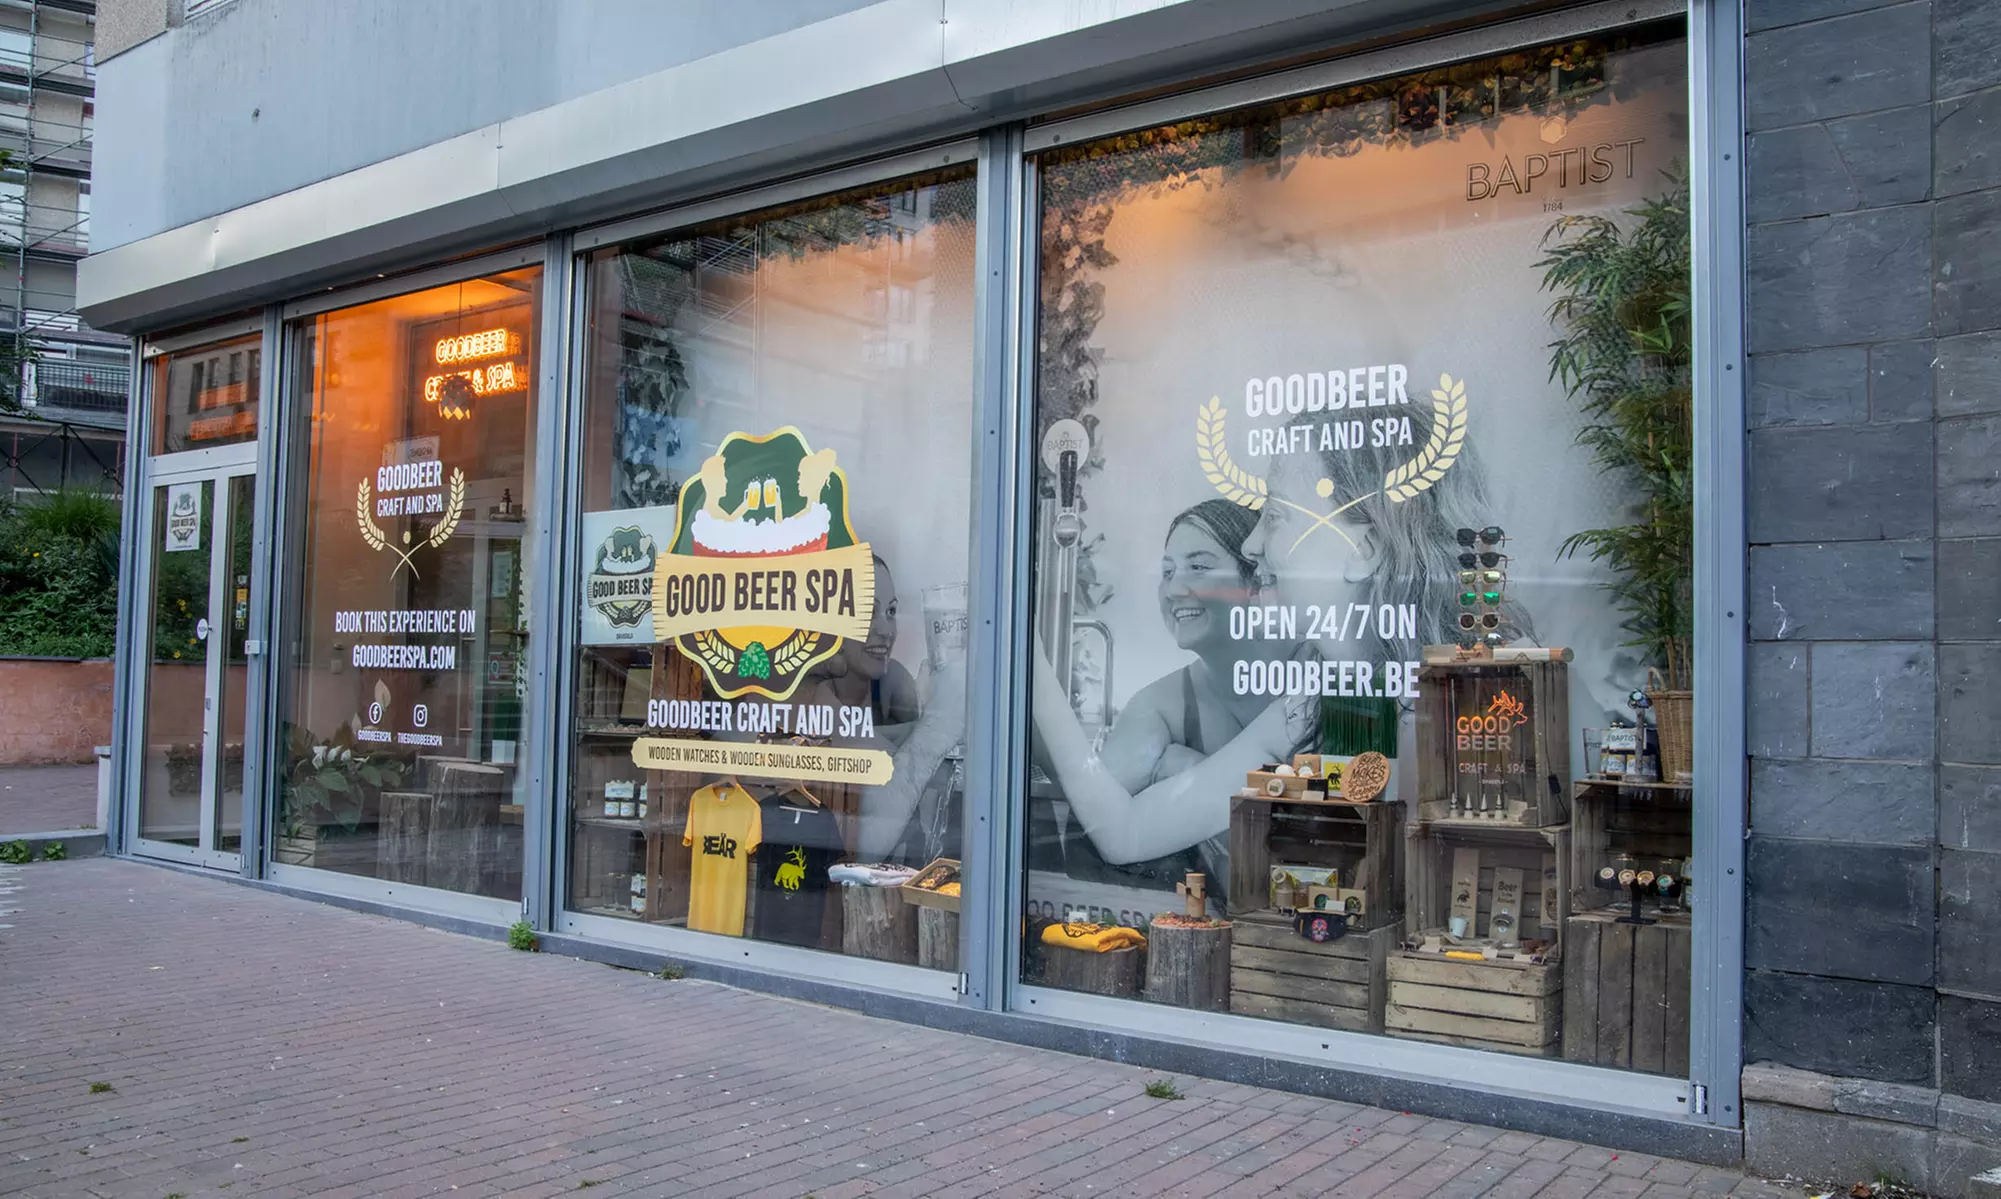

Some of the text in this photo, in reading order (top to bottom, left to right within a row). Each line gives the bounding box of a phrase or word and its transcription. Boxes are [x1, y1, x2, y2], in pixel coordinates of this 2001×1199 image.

[1465, 137, 1645, 201] BAPTIST
[1543, 202, 1563, 213] 1784
[436, 328, 506, 363] GOODBEER
[486, 362, 515, 391] SPA
[1245, 363, 1408, 418] GOODBEER
[1248, 417, 1413, 457] CRAFT AND SPA
[377, 460, 443, 492] GOODBEER
[377, 493, 443, 517] CRAFT AND SPA
[593, 580, 615, 599] GOOD
[618, 578, 640, 596] BEER
[666, 568, 856, 618] GOOD BEER SPA
[335, 609, 476, 633] BOOK THIS EXPERIENCE ON
[1229, 602, 1416, 642] OPEN 24/7 ON
[352, 644, 456, 669] GOODBEERSPA.COM
[1233, 659, 1421, 698] GOODBEER.BE
[647, 699, 875, 739] GOODBEER CRAFT AND SPA
[1457, 715, 1511, 734] GOOD
[357, 730, 443, 746] GOODBEERSPA THEGOODBEERSPA
[1457, 735, 1512, 751] BEER
[648, 746, 872, 774] WOODEN WATCHES & WOODEN SUNGLASSES, GIFTSHOP
[1458, 762, 1488, 774] CRAFT
[1507, 762, 1526, 774] SPA
